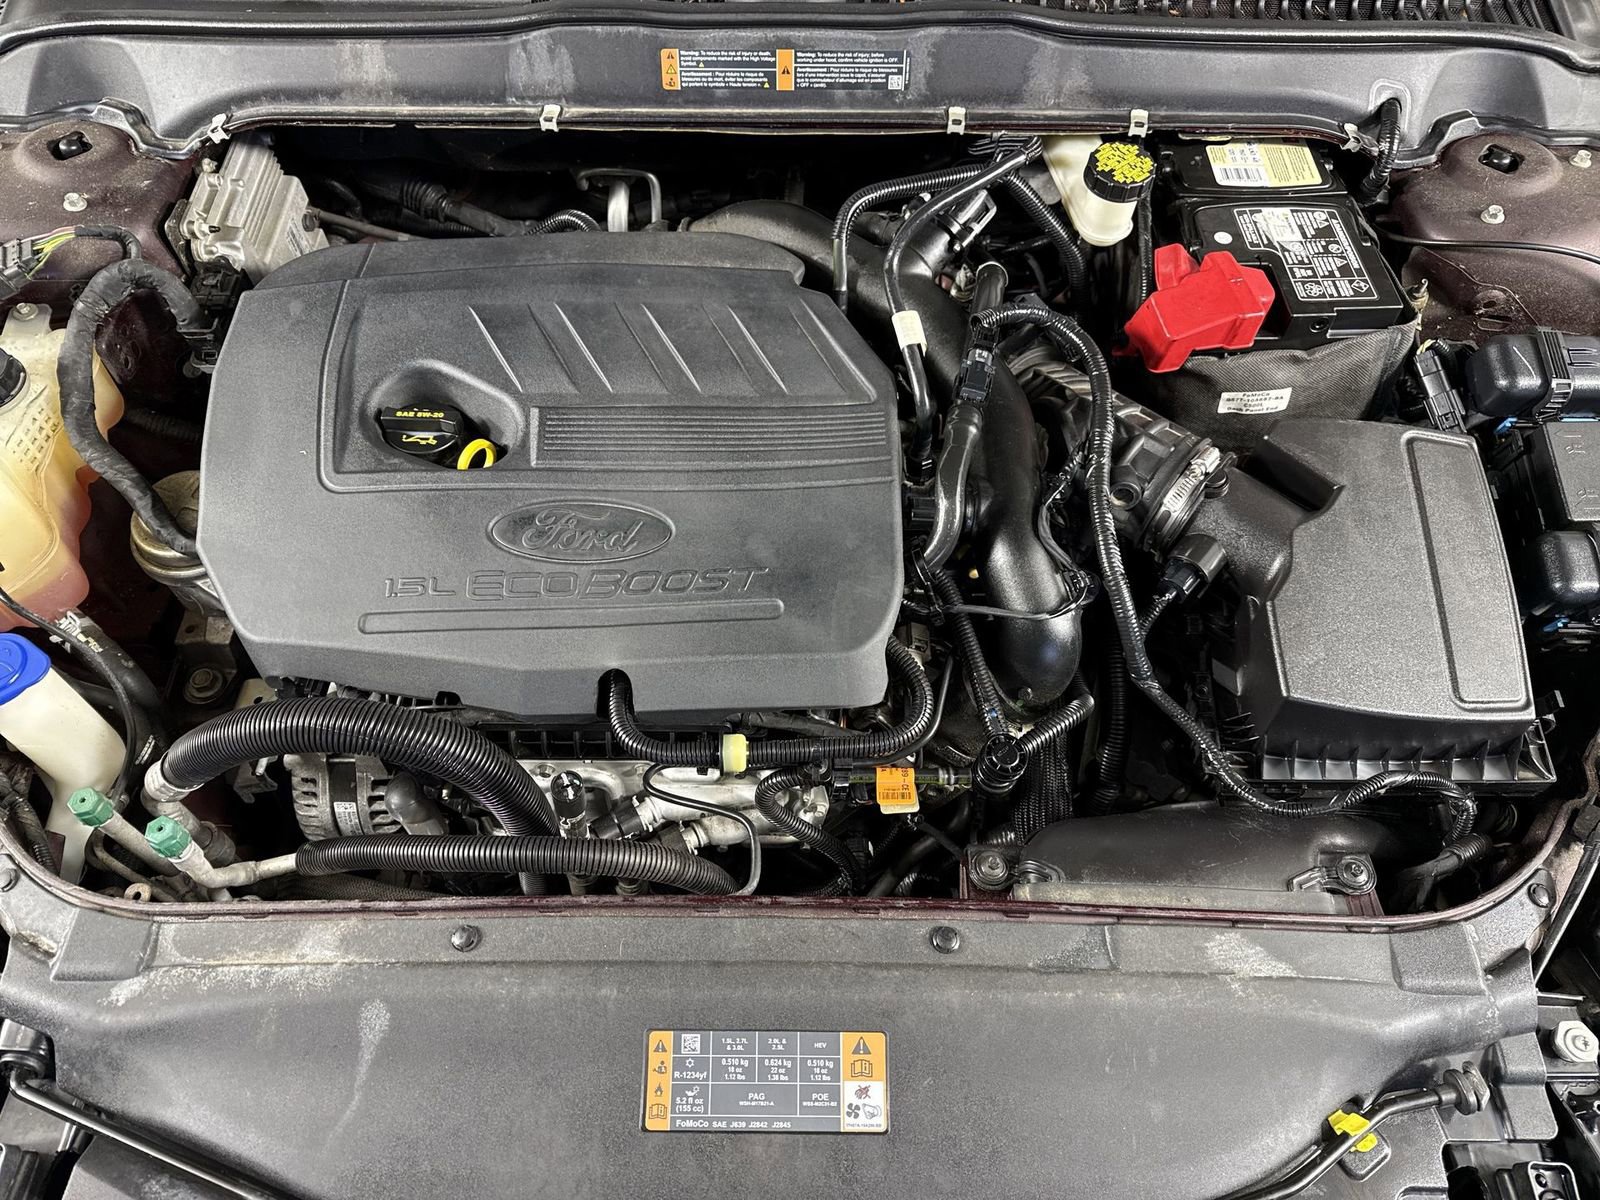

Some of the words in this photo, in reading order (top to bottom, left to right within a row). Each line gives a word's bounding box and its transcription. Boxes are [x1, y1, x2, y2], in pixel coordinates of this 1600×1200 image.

[522, 508, 644, 552] Ford
[384, 576, 457, 598] 1.5L
[466, 566, 769, 600] ECOBOOST
[740, 1059, 749, 1067] kg
[783, 1059, 791, 1067] kg
[674, 1072, 707, 1080] R-1234yf
[676, 1105, 691, 1113] (155
